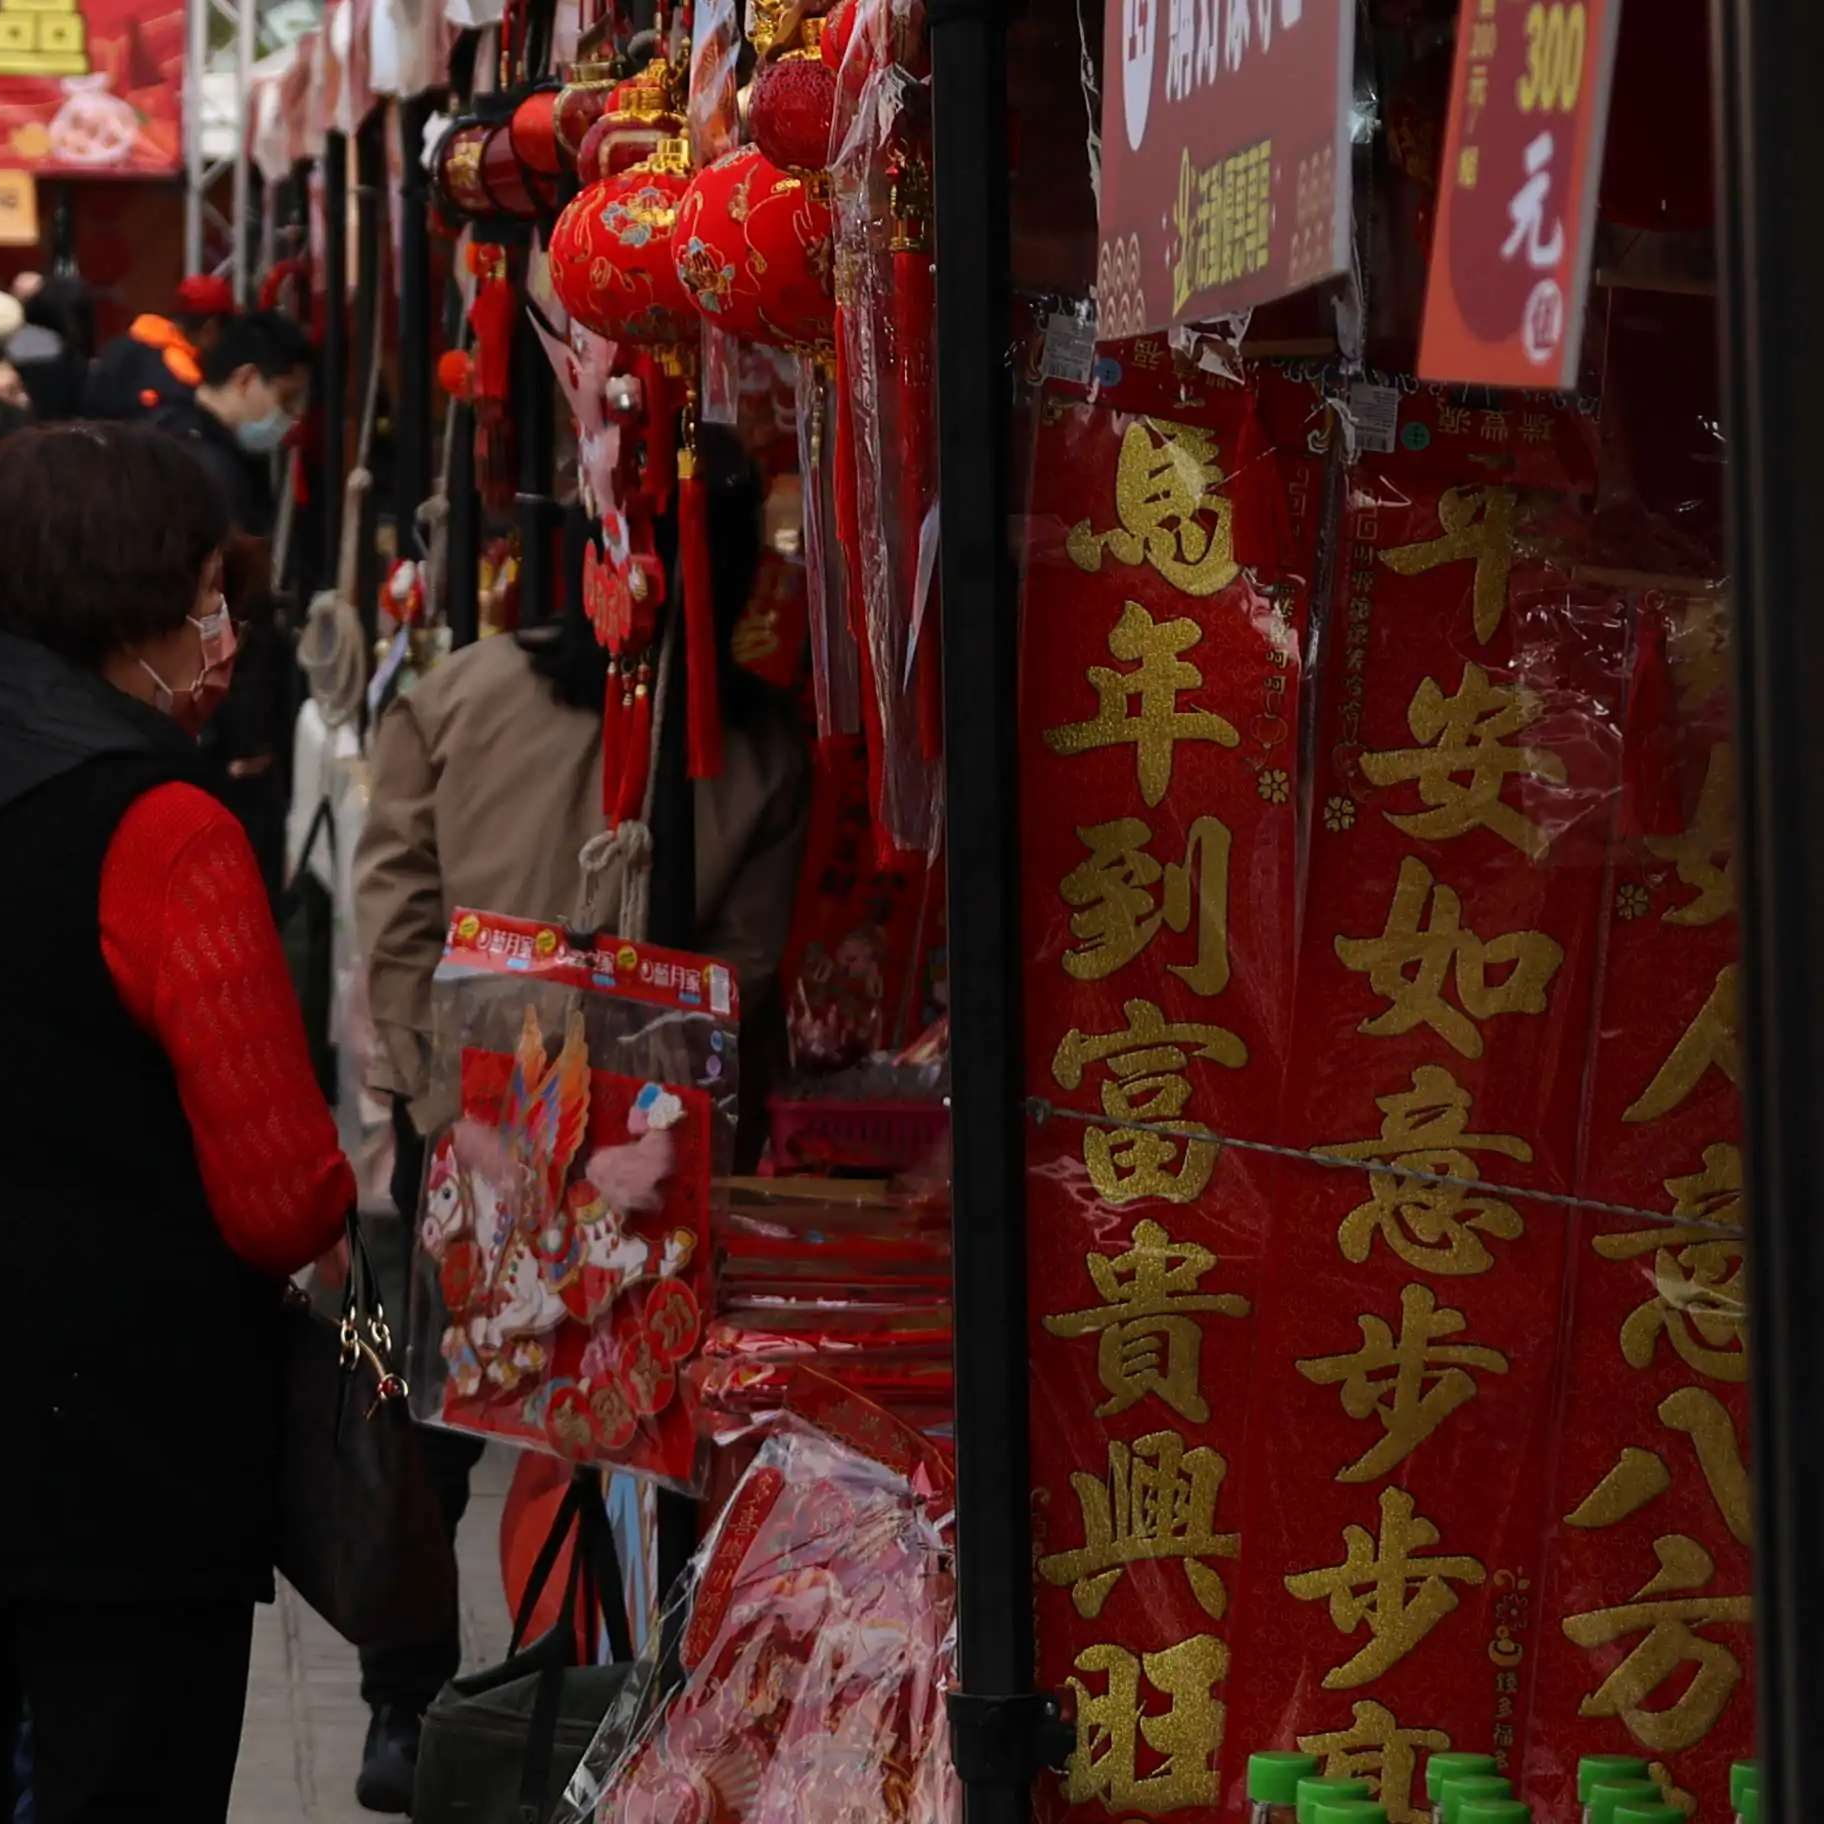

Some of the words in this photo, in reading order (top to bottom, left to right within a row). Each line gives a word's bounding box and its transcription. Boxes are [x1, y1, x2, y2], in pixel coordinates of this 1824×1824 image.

[1039, 420, 1250, 1809] 馬年到富貴興旺
